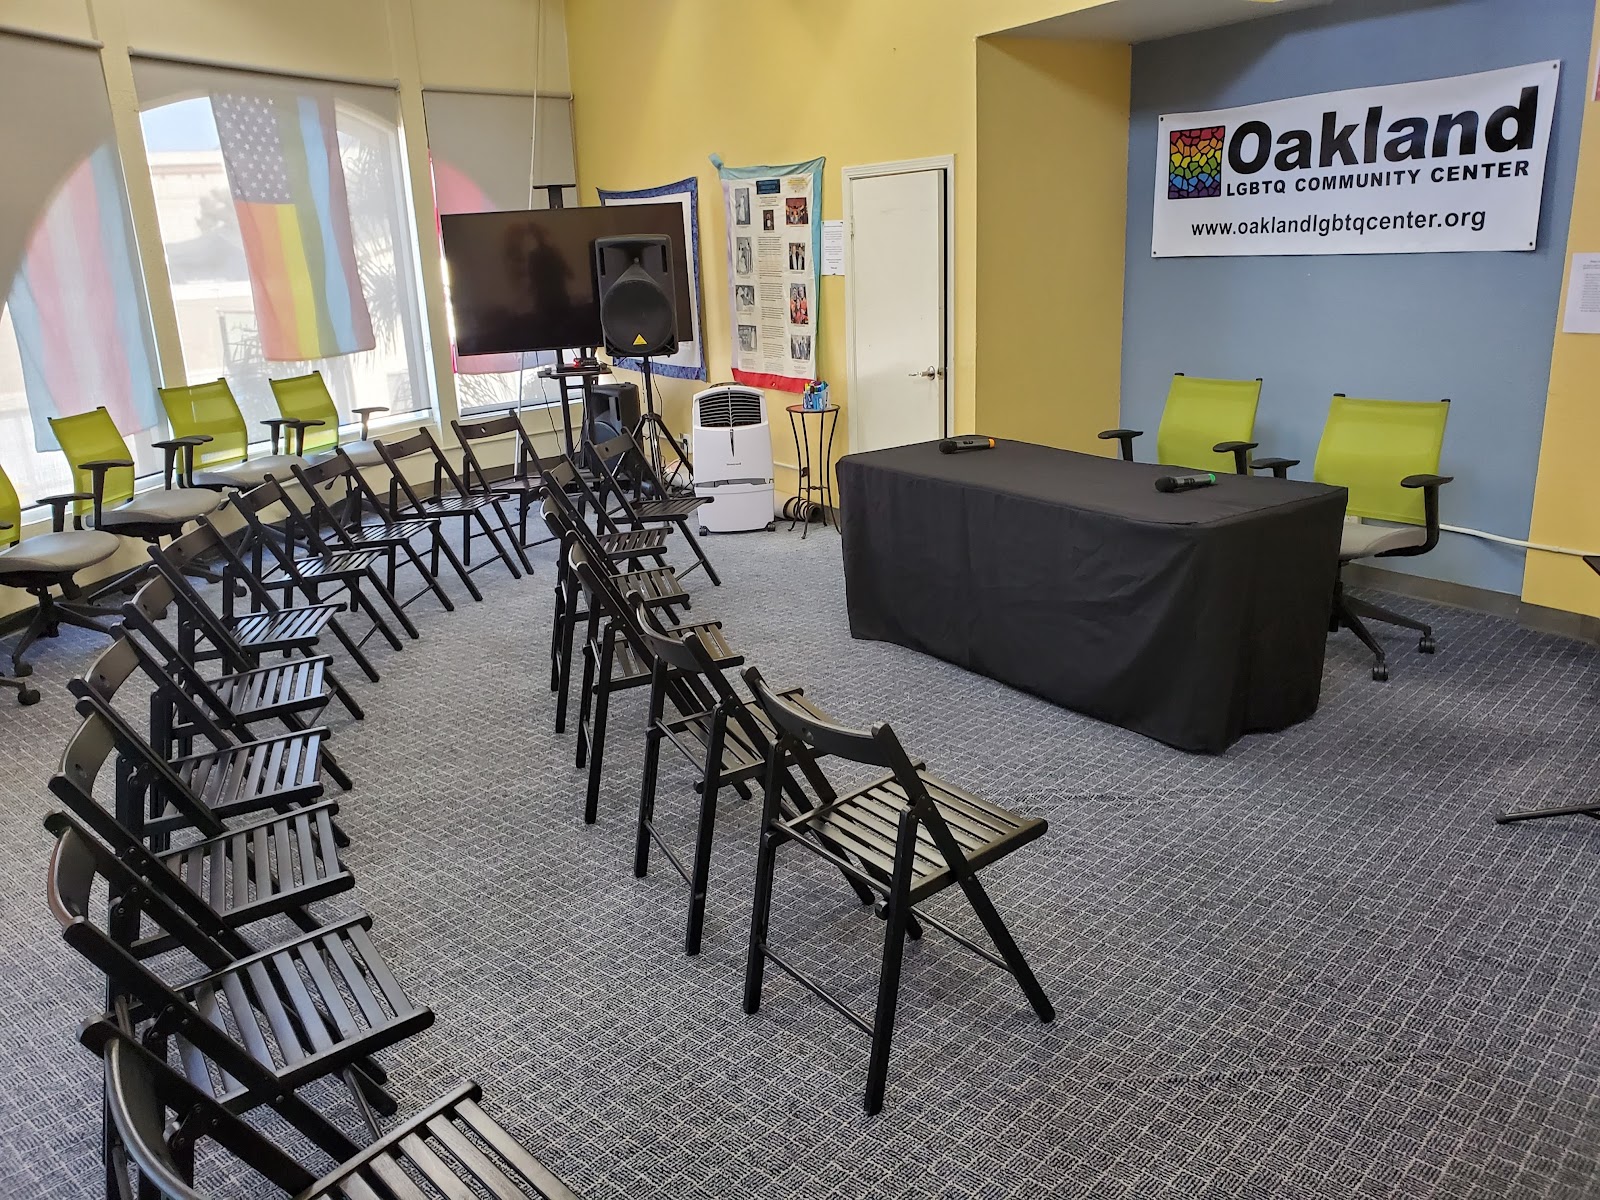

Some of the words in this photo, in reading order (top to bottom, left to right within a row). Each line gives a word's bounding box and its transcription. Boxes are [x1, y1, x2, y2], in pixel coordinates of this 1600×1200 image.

[1227, 85, 1539, 175] Oakland
[1226, 179, 1286, 197] LGBTQ
[1294, 168, 1421, 192] COMMUNITY
[1430, 160, 1530, 184] CENTER
[1191, 207, 1486, 237] www.oaklandlgbtqcenter.org
